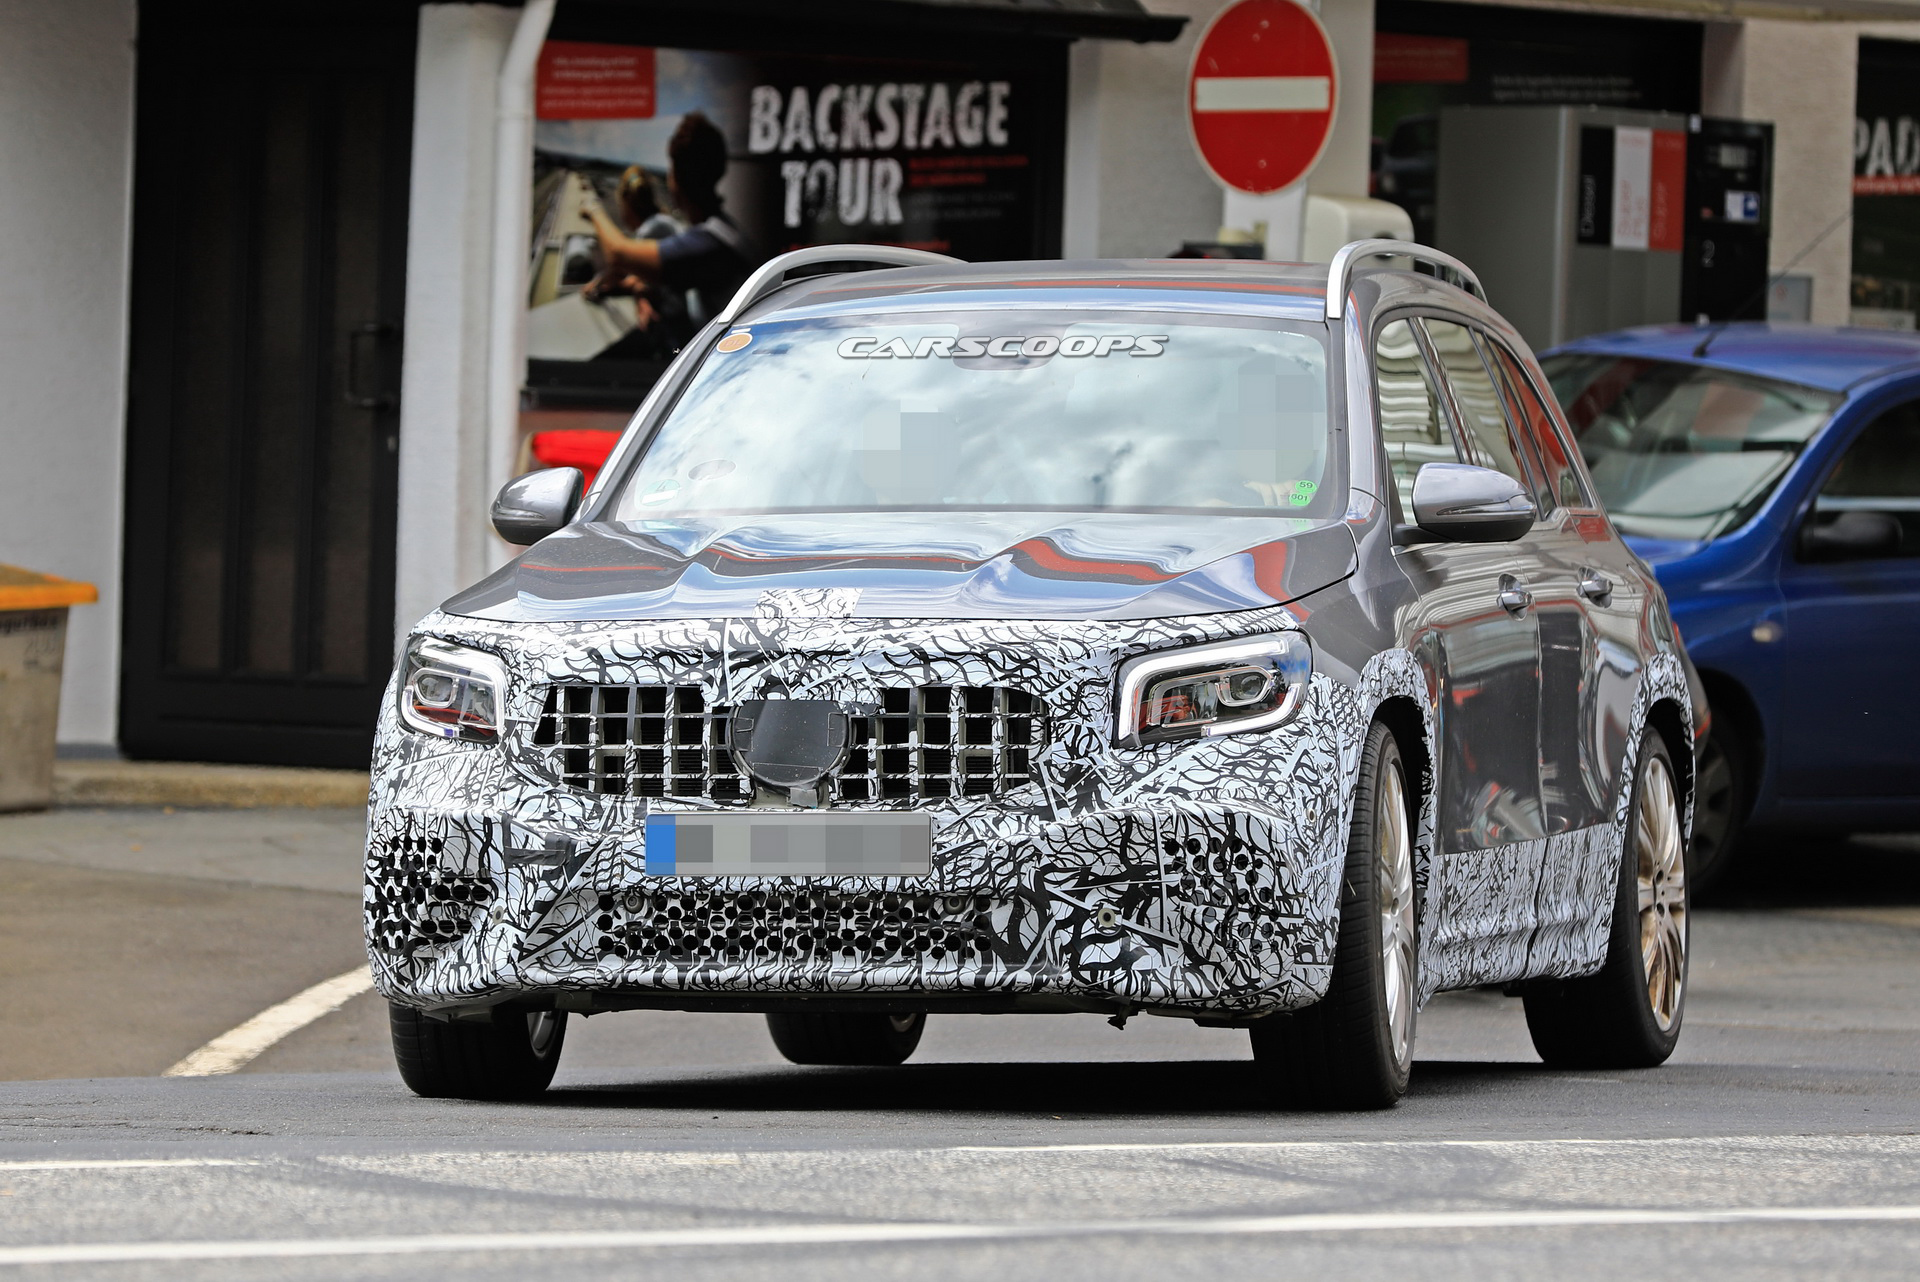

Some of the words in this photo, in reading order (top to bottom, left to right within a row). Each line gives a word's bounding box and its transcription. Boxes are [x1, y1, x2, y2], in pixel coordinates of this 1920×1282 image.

[748, 82, 1010, 153] BACKSTAGE
[781, 157, 905, 228] TOUR
[1299, 481, 1313, 489] 59
